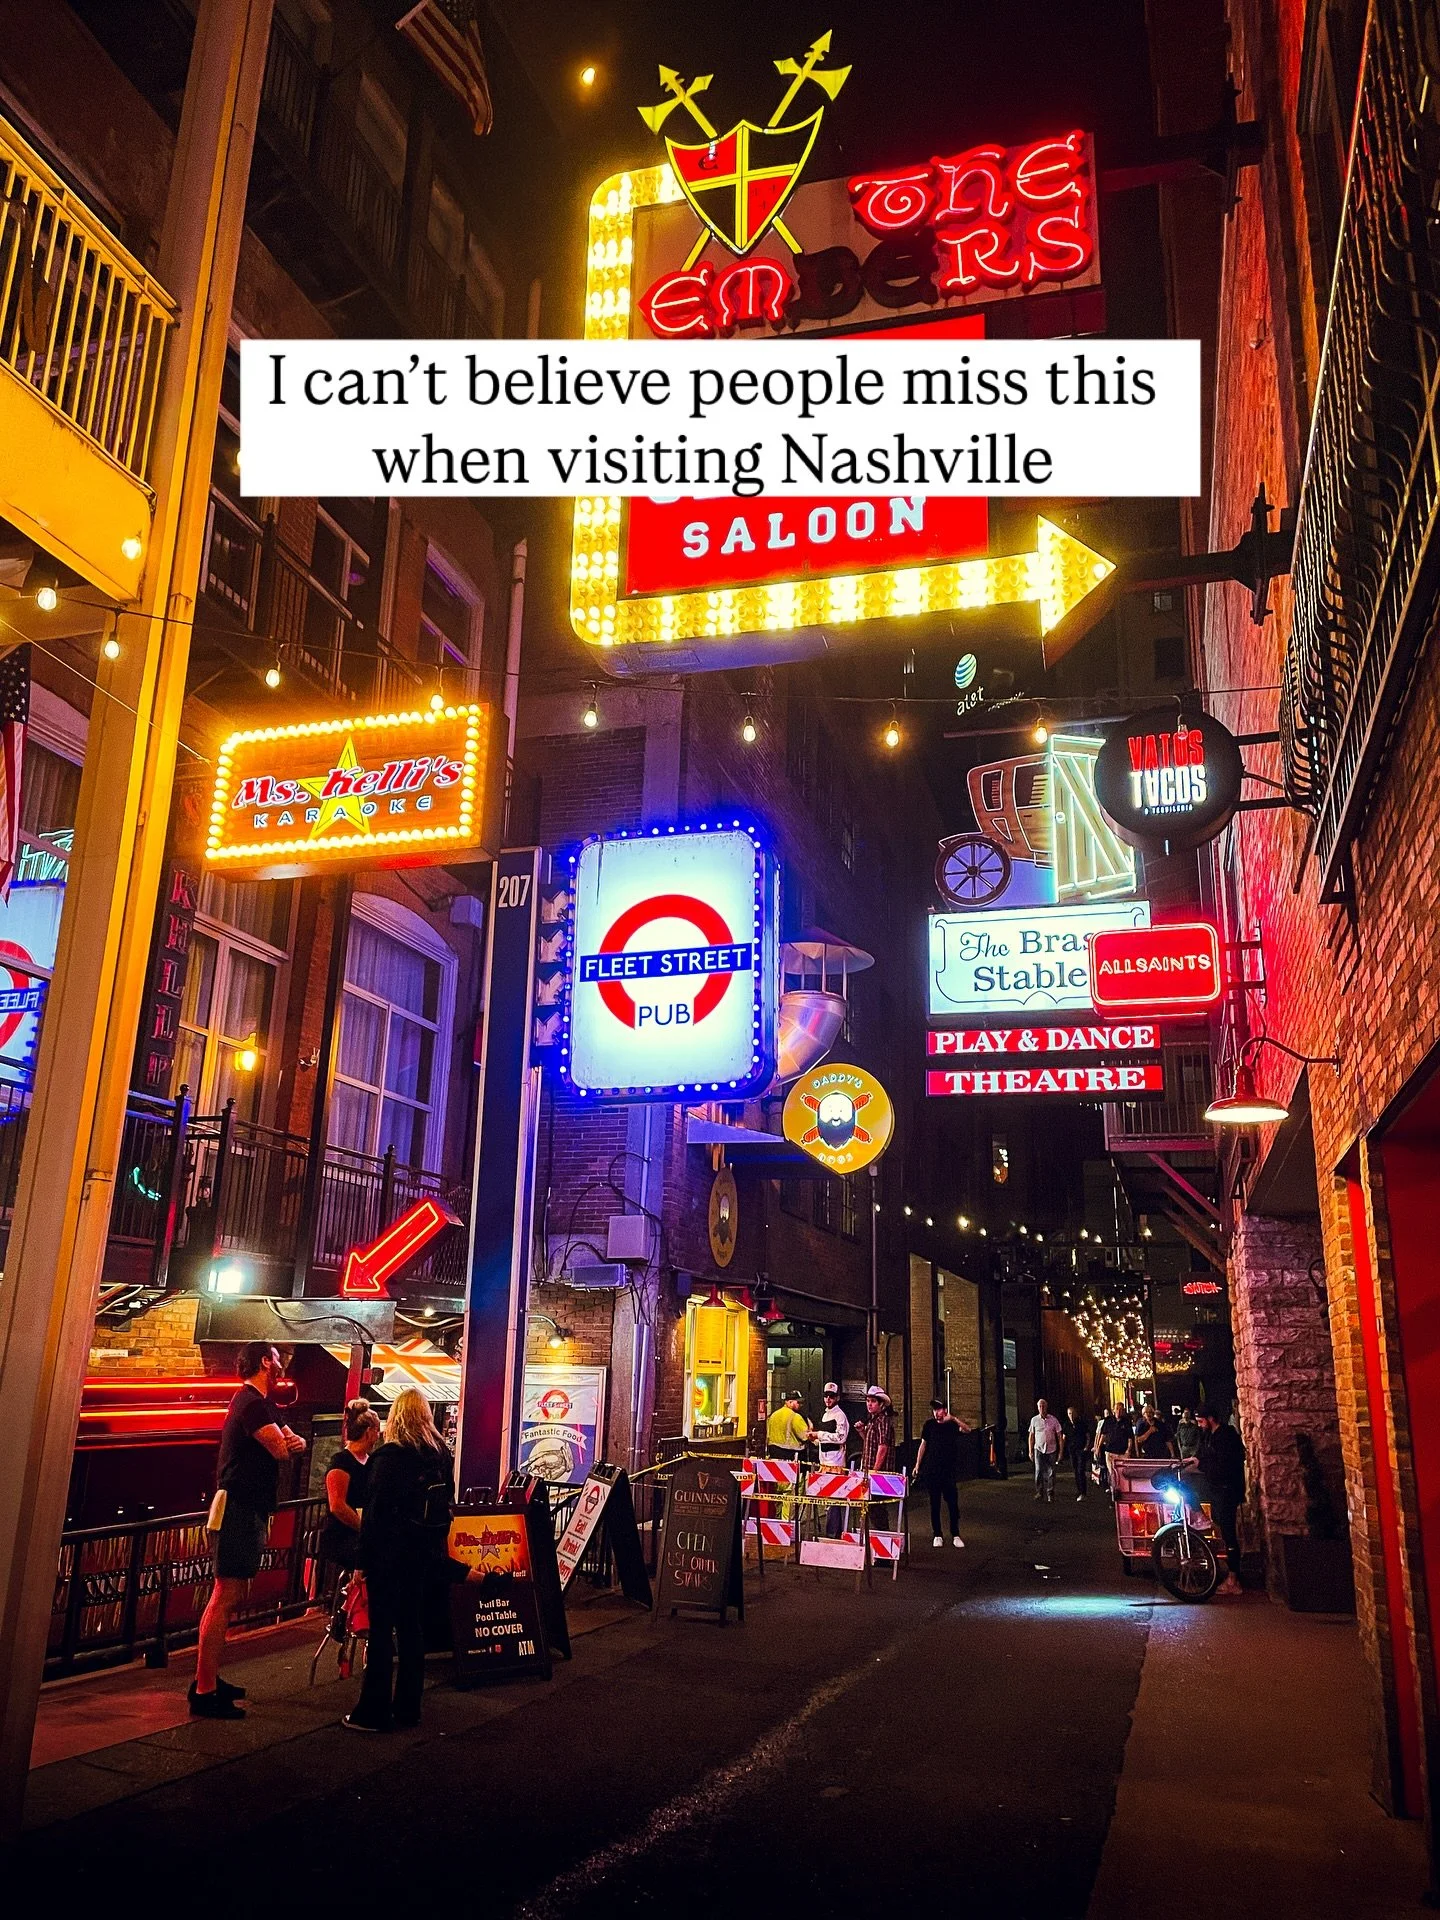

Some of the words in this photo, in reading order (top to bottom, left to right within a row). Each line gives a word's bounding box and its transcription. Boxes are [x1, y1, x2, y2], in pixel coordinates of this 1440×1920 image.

[682, 496, 927, 559] SALOON
[957, 686, 984, 716] at&t
[1128, 730, 1205, 772] VATOS
[232, 775, 312, 809] Ms.
[320, 755, 466, 800] Kelli's
[1130, 764, 1208, 808] TACOS
[253, 795, 434, 830] KARAOKE
[498, 875, 531, 908] 207
[959, 931, 1011, 962] The
[1019, 930, 1092, 954] Bras
[585, 955, 653, 979] FLEET
[660, 947, 747, 974] STREET
[973, 961, 1088, 992] Stable
[1098, 954, 1212, 975] ALLSAINTS
[638, 1003, 691, 1027] PUB
[935, 1030, 1011, 1054] PLAY
[1018, 1029, 1040, 1051] &
[1046, 1026, 1155, 1051] DANCE
[945, 1067, 1146, 1094] THEATRE
[525, 1427, 560, 1439] Fantastic
[562, 1430, 583, 1443] Food
[674, 1489, 728, 1505] GUINNESS
[476, 1612, 494, 1622] Pool
[495, 1610, 517, 1620] Table
[496, 1599, 510, 1607] Bar
[475, 1627, 490, 1637] NO
[492, 1623, 523, 1636] COVER
[518, 1640, 535, 1656] ATM
